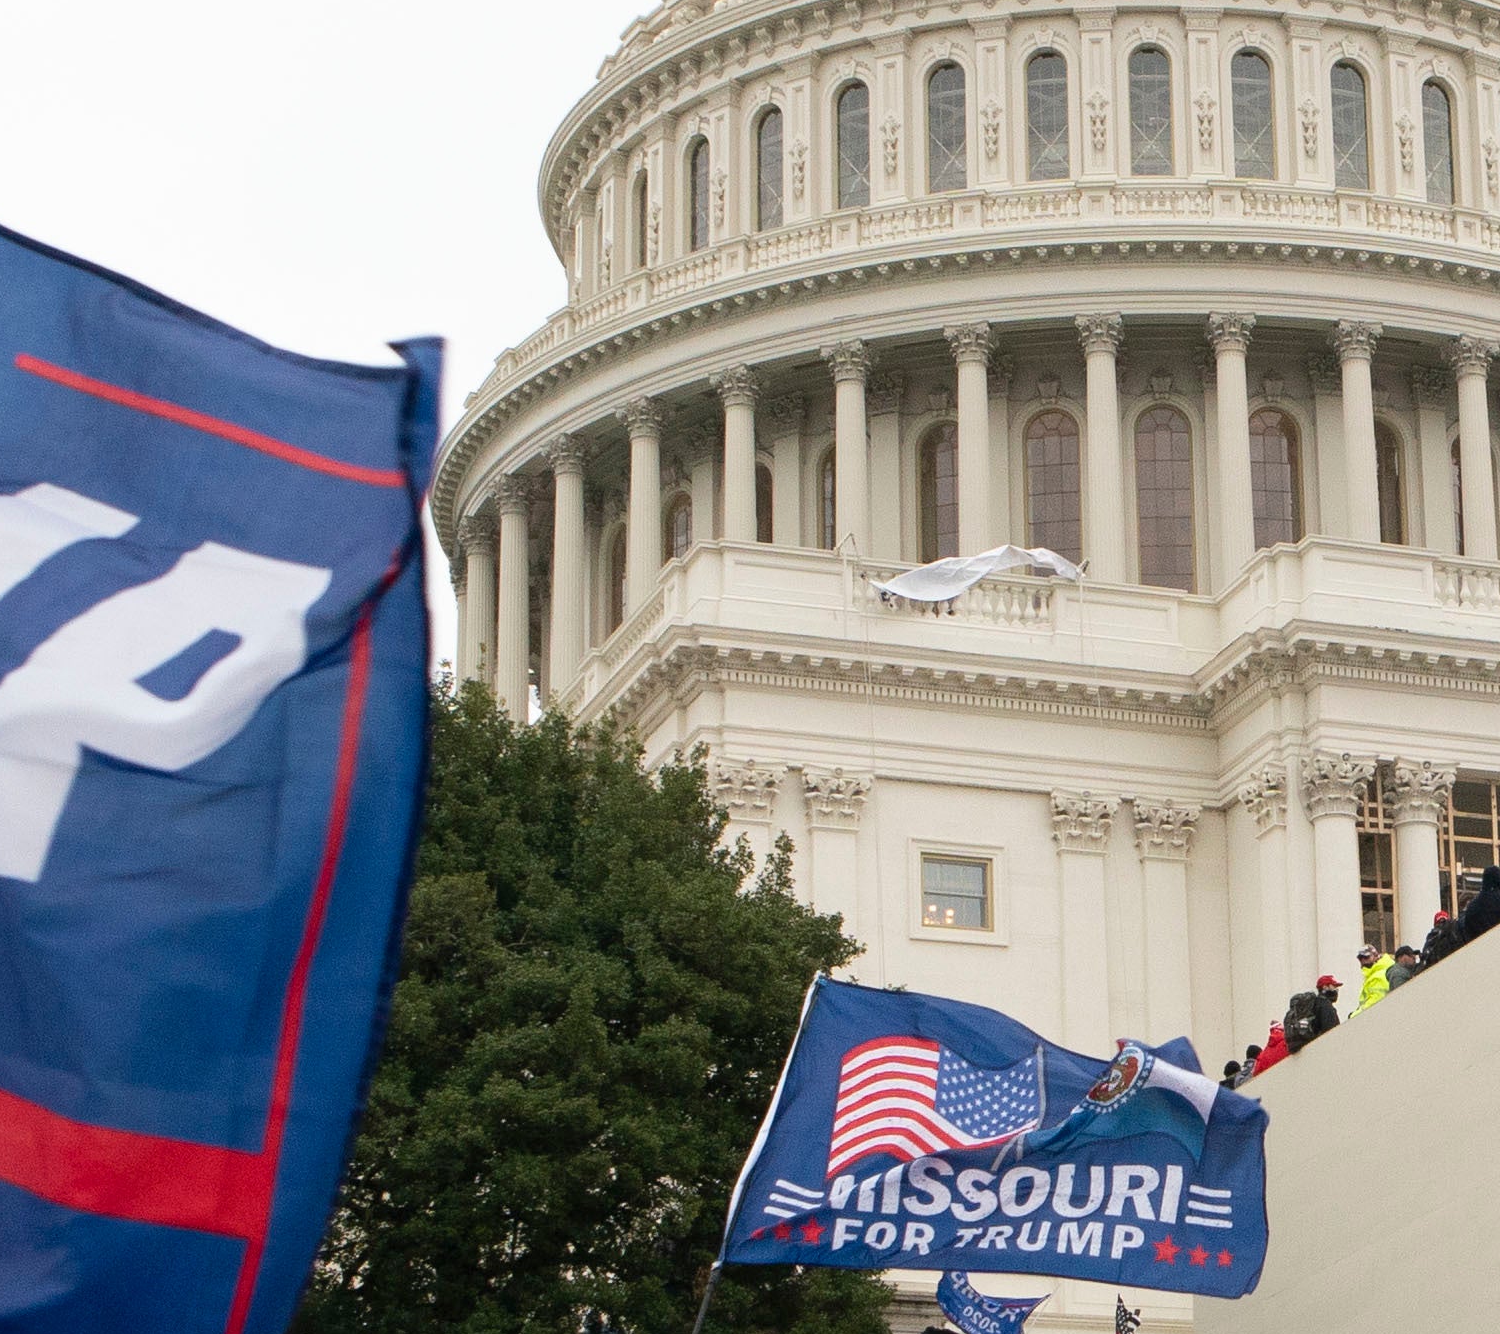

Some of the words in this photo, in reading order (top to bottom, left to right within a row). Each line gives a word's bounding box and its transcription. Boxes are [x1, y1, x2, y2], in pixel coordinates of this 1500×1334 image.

[829, 1156, 1184, 1225] MISSOURI
[831, 1218, 937, 1256] FOR
[953, 1224, 1146, 1260] TRUMP
